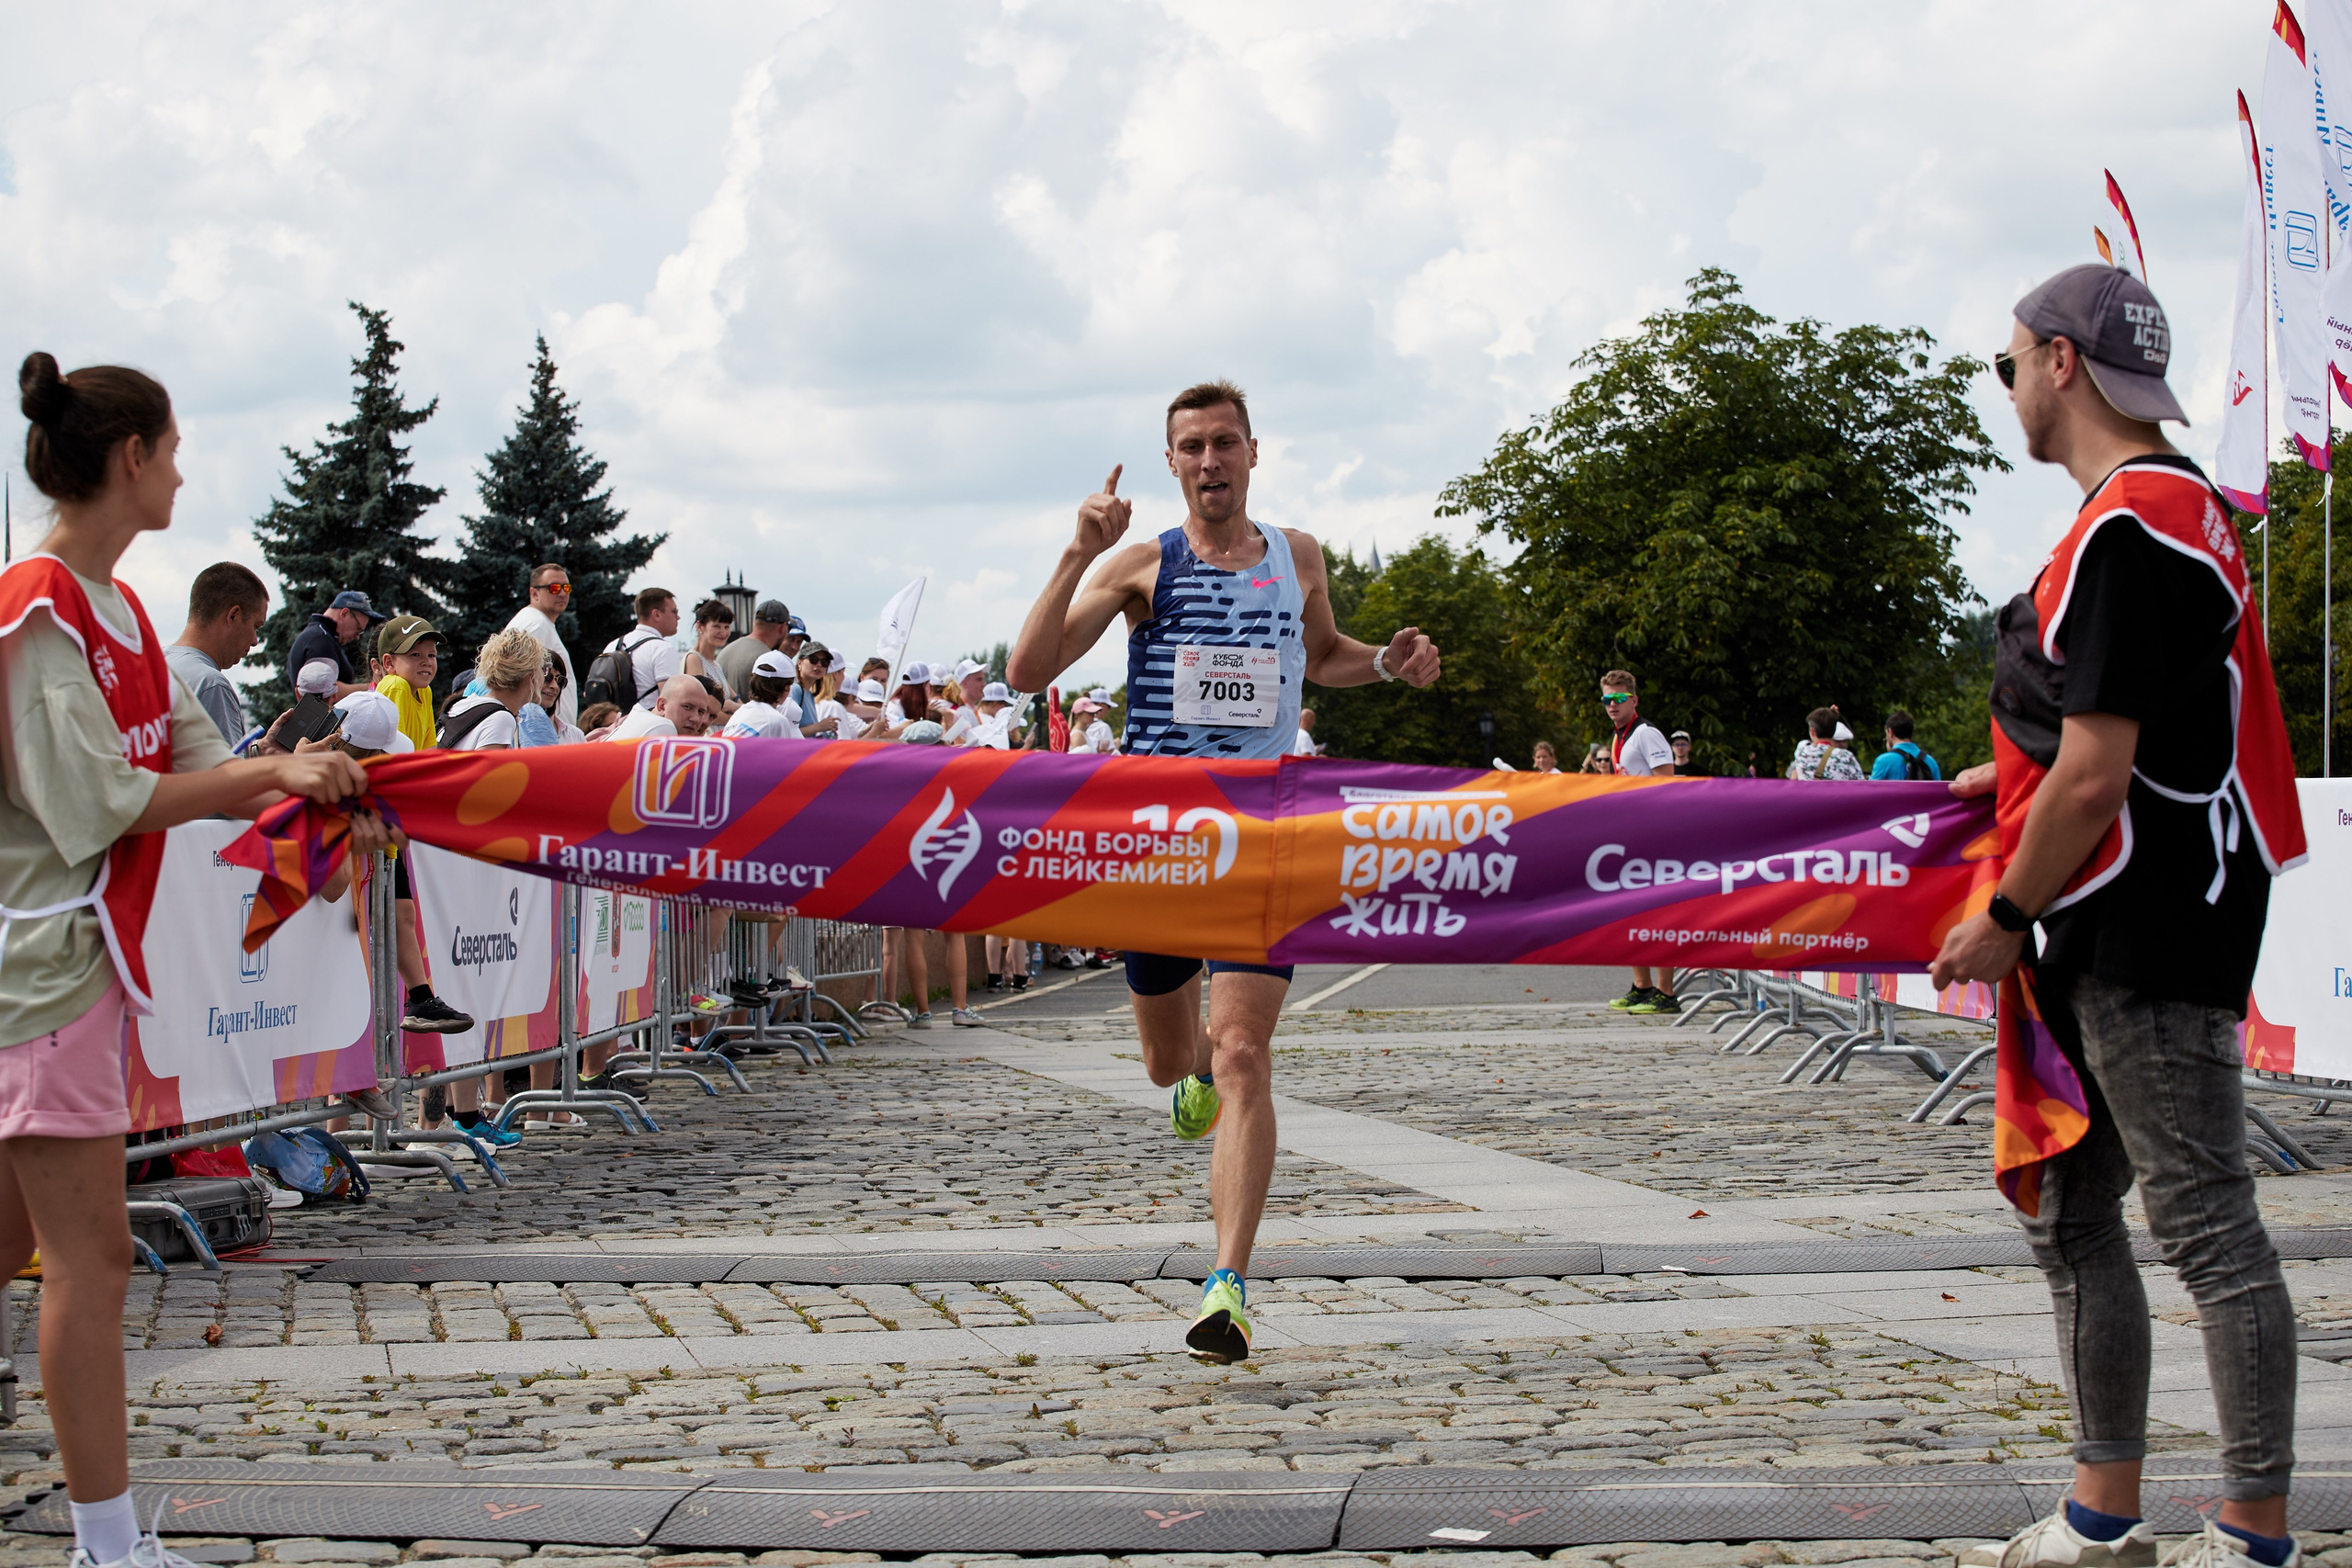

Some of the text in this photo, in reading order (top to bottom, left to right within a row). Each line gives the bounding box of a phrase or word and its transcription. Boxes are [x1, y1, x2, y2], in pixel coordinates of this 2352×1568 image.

[1204, 671, 1251, 680] СЕВЕРСТАЛЬ
[1212, 660, 1244, 668] ФОНДА
[1199, 681, 1255, 702] 7003
[997, 826, 1209, 857] ФОНД БОРЬБЫ
[1340, 803, 1514, 847] самое
[537, 834, 831, 889] Гарант-Инвест
[997, 854, 1209, 886] С ЛЕЙКЕМИЕЙ
[1340, 842, 1519, 899] время
[1584, 842, 1911, 895] Северсталь
[1329, 892, 1467, 939] жить
[451, 925, 518, 977] Северсталь
[1628, 926, 1870, 953] генеральный партнёр
[207, 1000, 299, 1044] Гарант-Инвест
